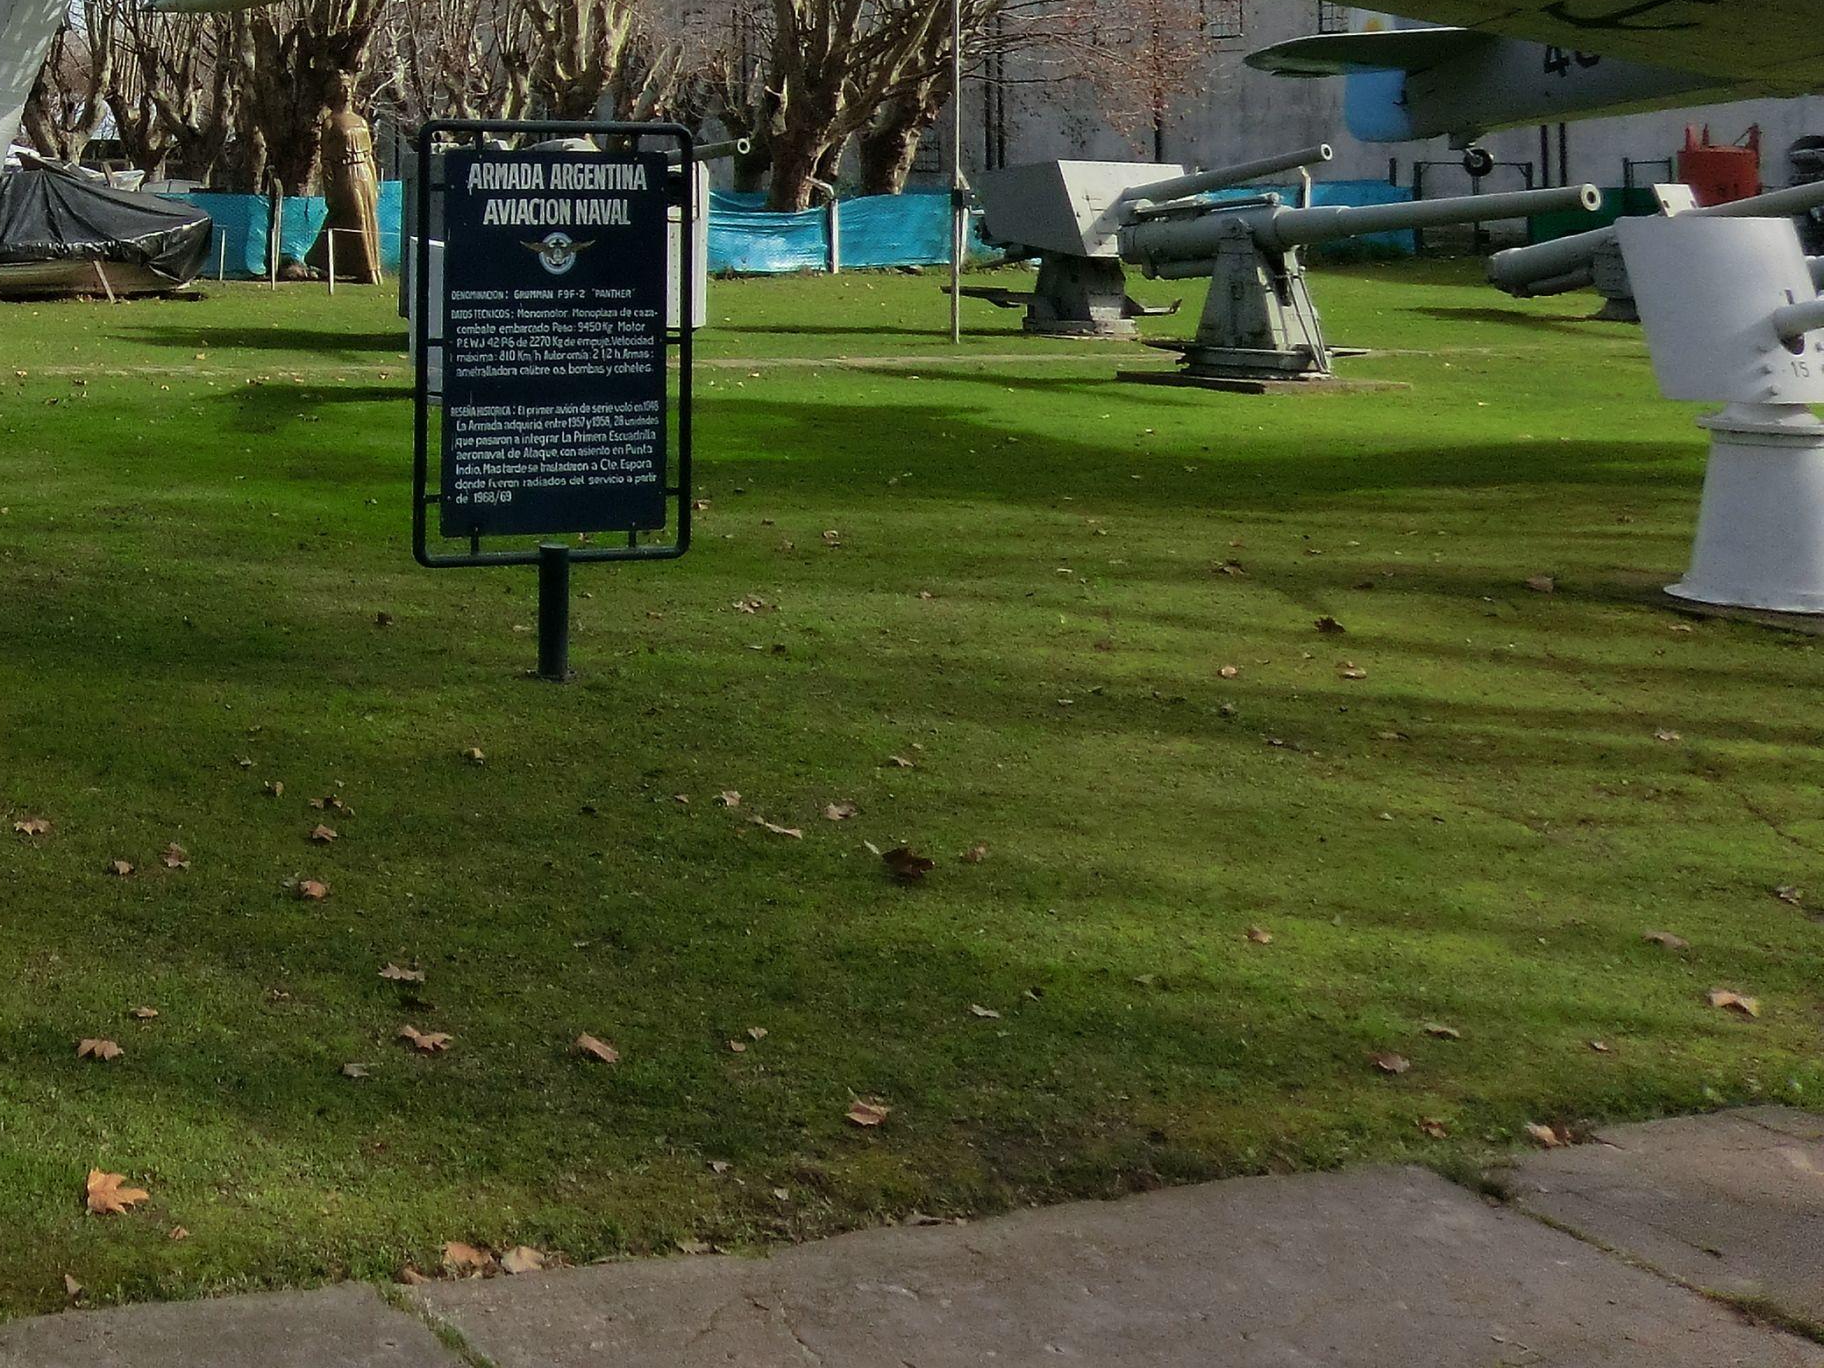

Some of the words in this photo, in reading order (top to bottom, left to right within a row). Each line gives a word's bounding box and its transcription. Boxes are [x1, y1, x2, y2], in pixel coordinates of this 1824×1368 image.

[467, 163, 544, 190] ARMADA
[550, 163, 647, 190] ARGENTINA
[483, 199, 571, 225] AVIACION
[576, 199, 631, 225] NAVAL
[514, 289, 553, 299] GRUMMAN
[451, 309, 473, 320] DATOS
[620, 307, 631, 317] de
[456, 323, 496, 334] combate
[498, 322, 550, 334] embarcado
[577, 321, 601, 332] 9450
[617, 320, 645, 332] Motor
[487, 337, 499, 347] 42
[516, 336, 527, 347] de
[529, 335, 551, 347] 2270
[563, 336, 576, 346] de
[519, 364, 550, 375] calibre
[568, 362, 605, 374] bombas
[606, 365, 613, 377] y
[1791, 361, 1809, 378] 15
[517, 405, 525, 415] El
[526, 406, 554, 418] primer
[579, 402, 591, 413] de
[591, 402, 613, 413] serie
[456, 420, 467, 432] La
[468, 419, 503, 431] Armada
[544, 417, 568, 430] entre
[586, 418, 592, 430] y
[624, 414, 659, 426] unidades
[455, 437, 474, 449] que
[476, 436, 513, 448] pasaron
[514, 436, 521, 444] a
[521, 433, 560, 447] integrar
[573, 430, 607, 443] Primera
[609, 429, 656, 442] Escuadrilla
[456, 448, 505, 461] aeronaval
[507, 447, 521, 459] de
[559, 448, 576, 457] con
[577, 445, 611, 457] asiento
[612, 447, 624, 455] en
[625, 443, 653, 455] Punta
[502, 462, 527, 474] tarde
[527, 464, 538, 473] se
[540, 461, 589, 473] trasladaron
[591, 462, 598, 471] a
[620, 458, 652, 472] Espora
[455, 478, 486, 490] donde
[488, 478, 519, 488] fueron
[522, 476, 566, 487] radiados
[569, 475, 585, 485] del
[588, 475, 624, 485] servicio
[626, 475, 633, 483] a
[634, 472, 657, 485] partir
[456, 492, 468, 504] de
